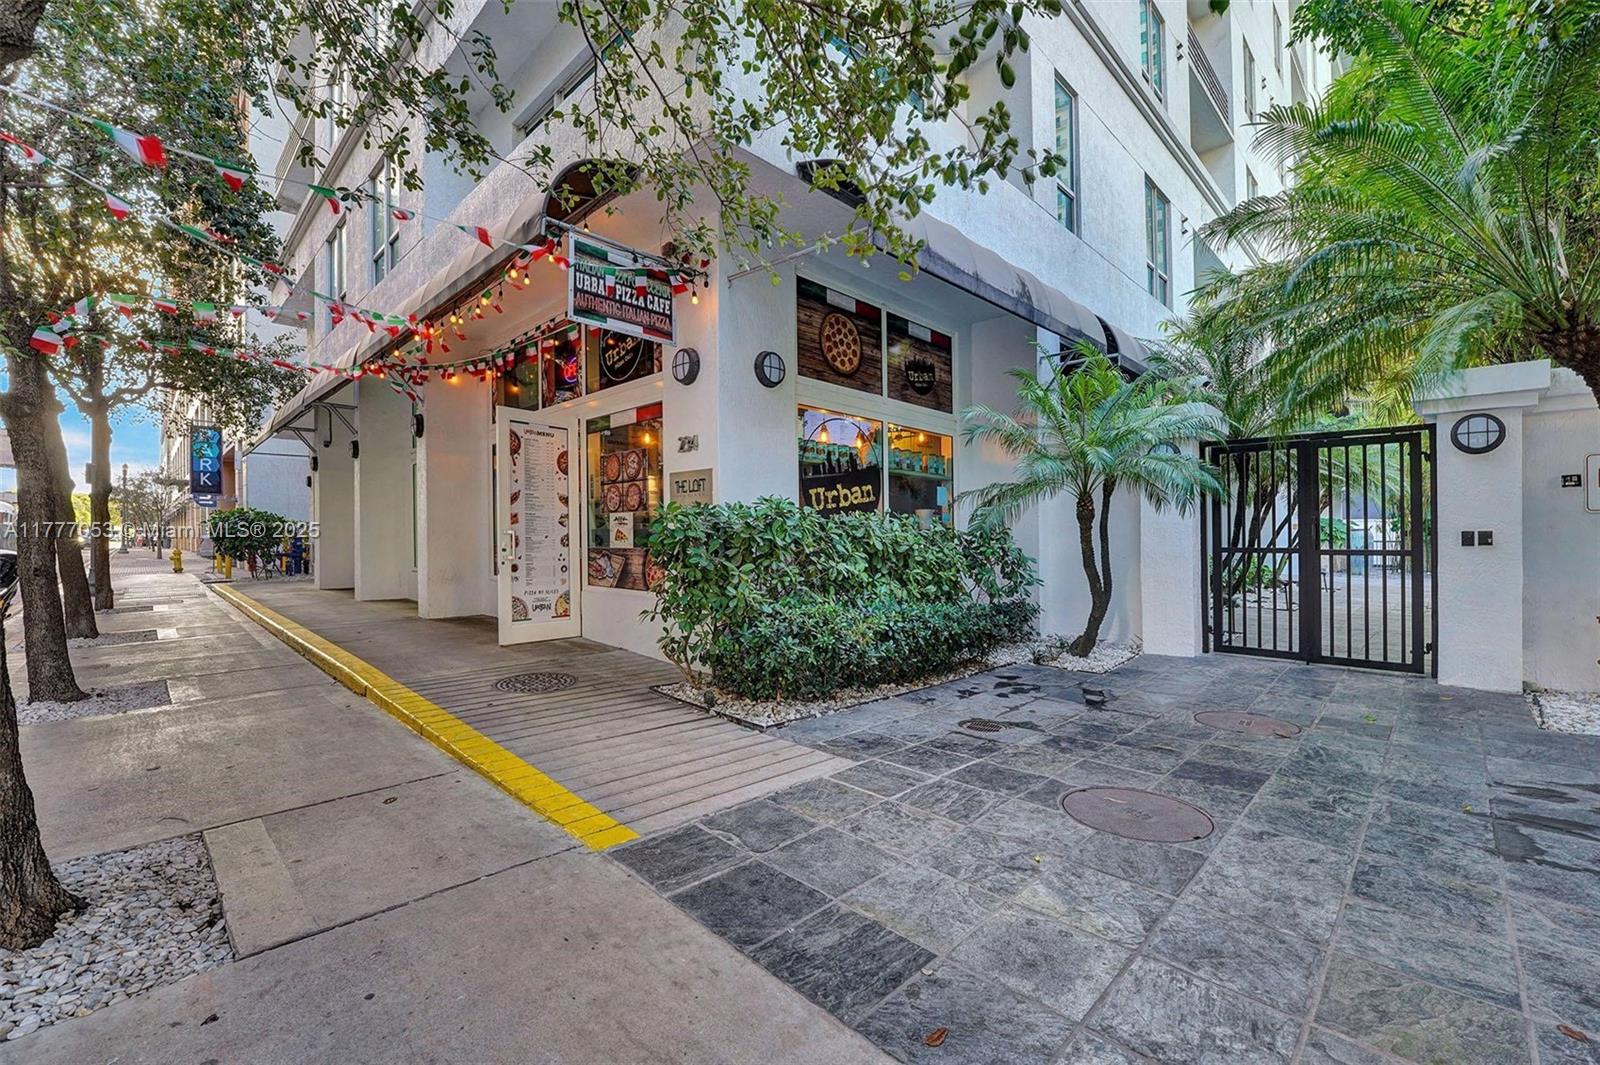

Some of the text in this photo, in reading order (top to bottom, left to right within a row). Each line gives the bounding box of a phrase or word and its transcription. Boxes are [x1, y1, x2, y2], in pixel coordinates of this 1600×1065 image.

[575, 291, 621, 316] AUTHENTIC
[615, 284, 645, 308] PIZZA
[646, 295, 671, 315] CAFE
[907, 371, 934, 381] Urban
[199, 430, 214, 486] ARK
[675, 478, 706, 493] THE LOFT
[809, 483, 876, 511] Urban
